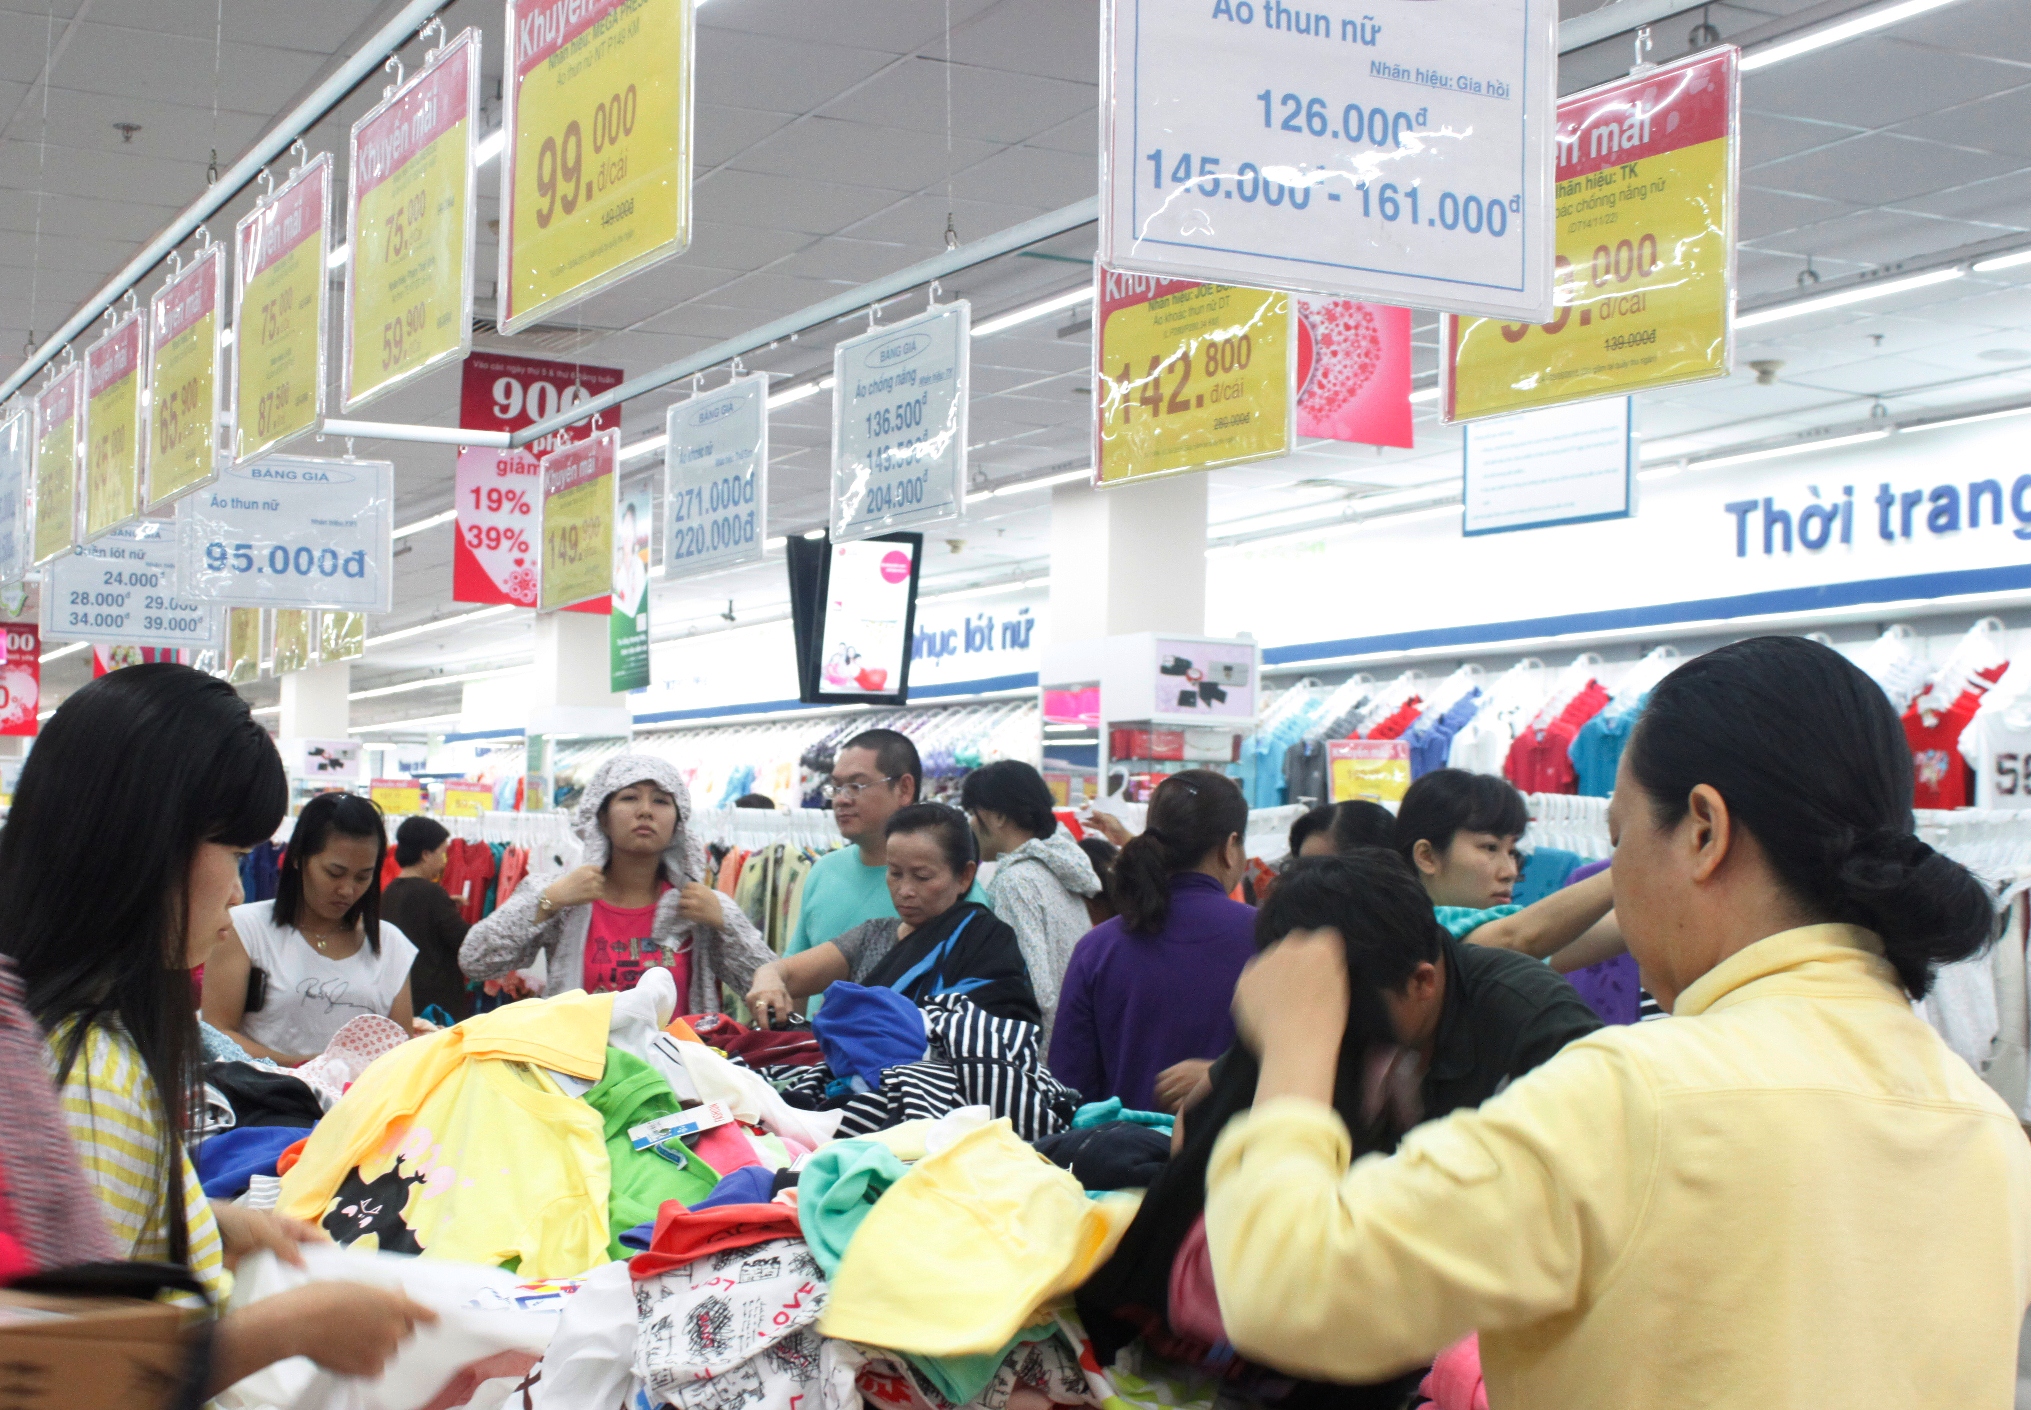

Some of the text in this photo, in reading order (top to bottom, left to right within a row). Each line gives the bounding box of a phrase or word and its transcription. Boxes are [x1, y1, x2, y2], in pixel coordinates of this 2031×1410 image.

[1263, 0, 1331, 40] thun
[1341, 15, 1382, 46] nữ
[1370, 60, 1411, 81] Nhãn
[1415, 66, 1453, 89] hiệu:
[1457, 75, 1483, 93] Gia
[1585, 171, 1617, 192] hiệu:
[1620, 161, 1639, 181] TK
[1209, 376, 1245, 404] đ/cái
[231, 497, 259, 510] thun
[262, 499, 280, 511] nữ
[470, 486, 531, 515] 19%
[1723, 484, 1855, 558] Thời
[110, 546, 126, 559] lót
[467, 524, 529, 554] 39%
[206, 542, 367, 578] 95.000đ
[964, 612, 995, 654] lót
[1001, 606, 1036, 651] nữ
